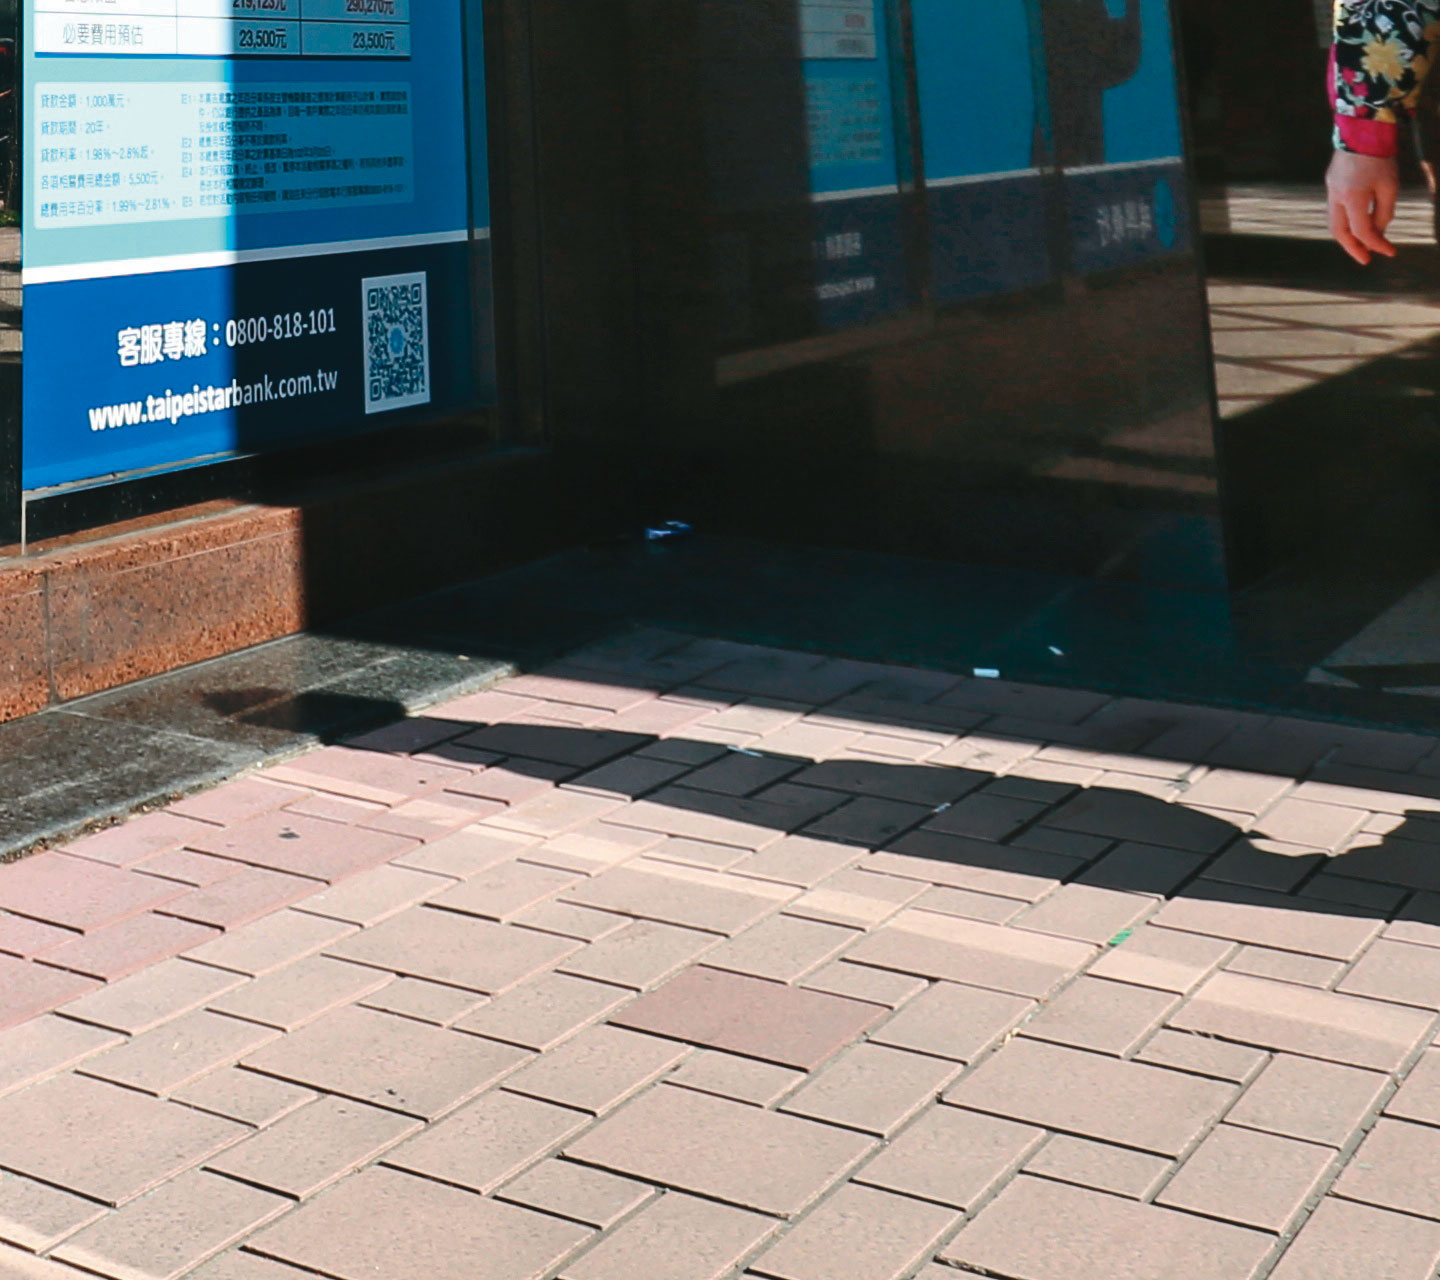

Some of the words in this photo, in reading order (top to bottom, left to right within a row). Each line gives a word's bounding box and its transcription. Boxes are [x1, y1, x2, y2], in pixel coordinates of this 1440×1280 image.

[63, 23, 144, 45] 必要費用預估
[239, 28, 287, 48] 23,500元
[353, 31, 395, 50] 23,500元
[88, 368, 338, 431] www.taipeistarbank.com.tw
